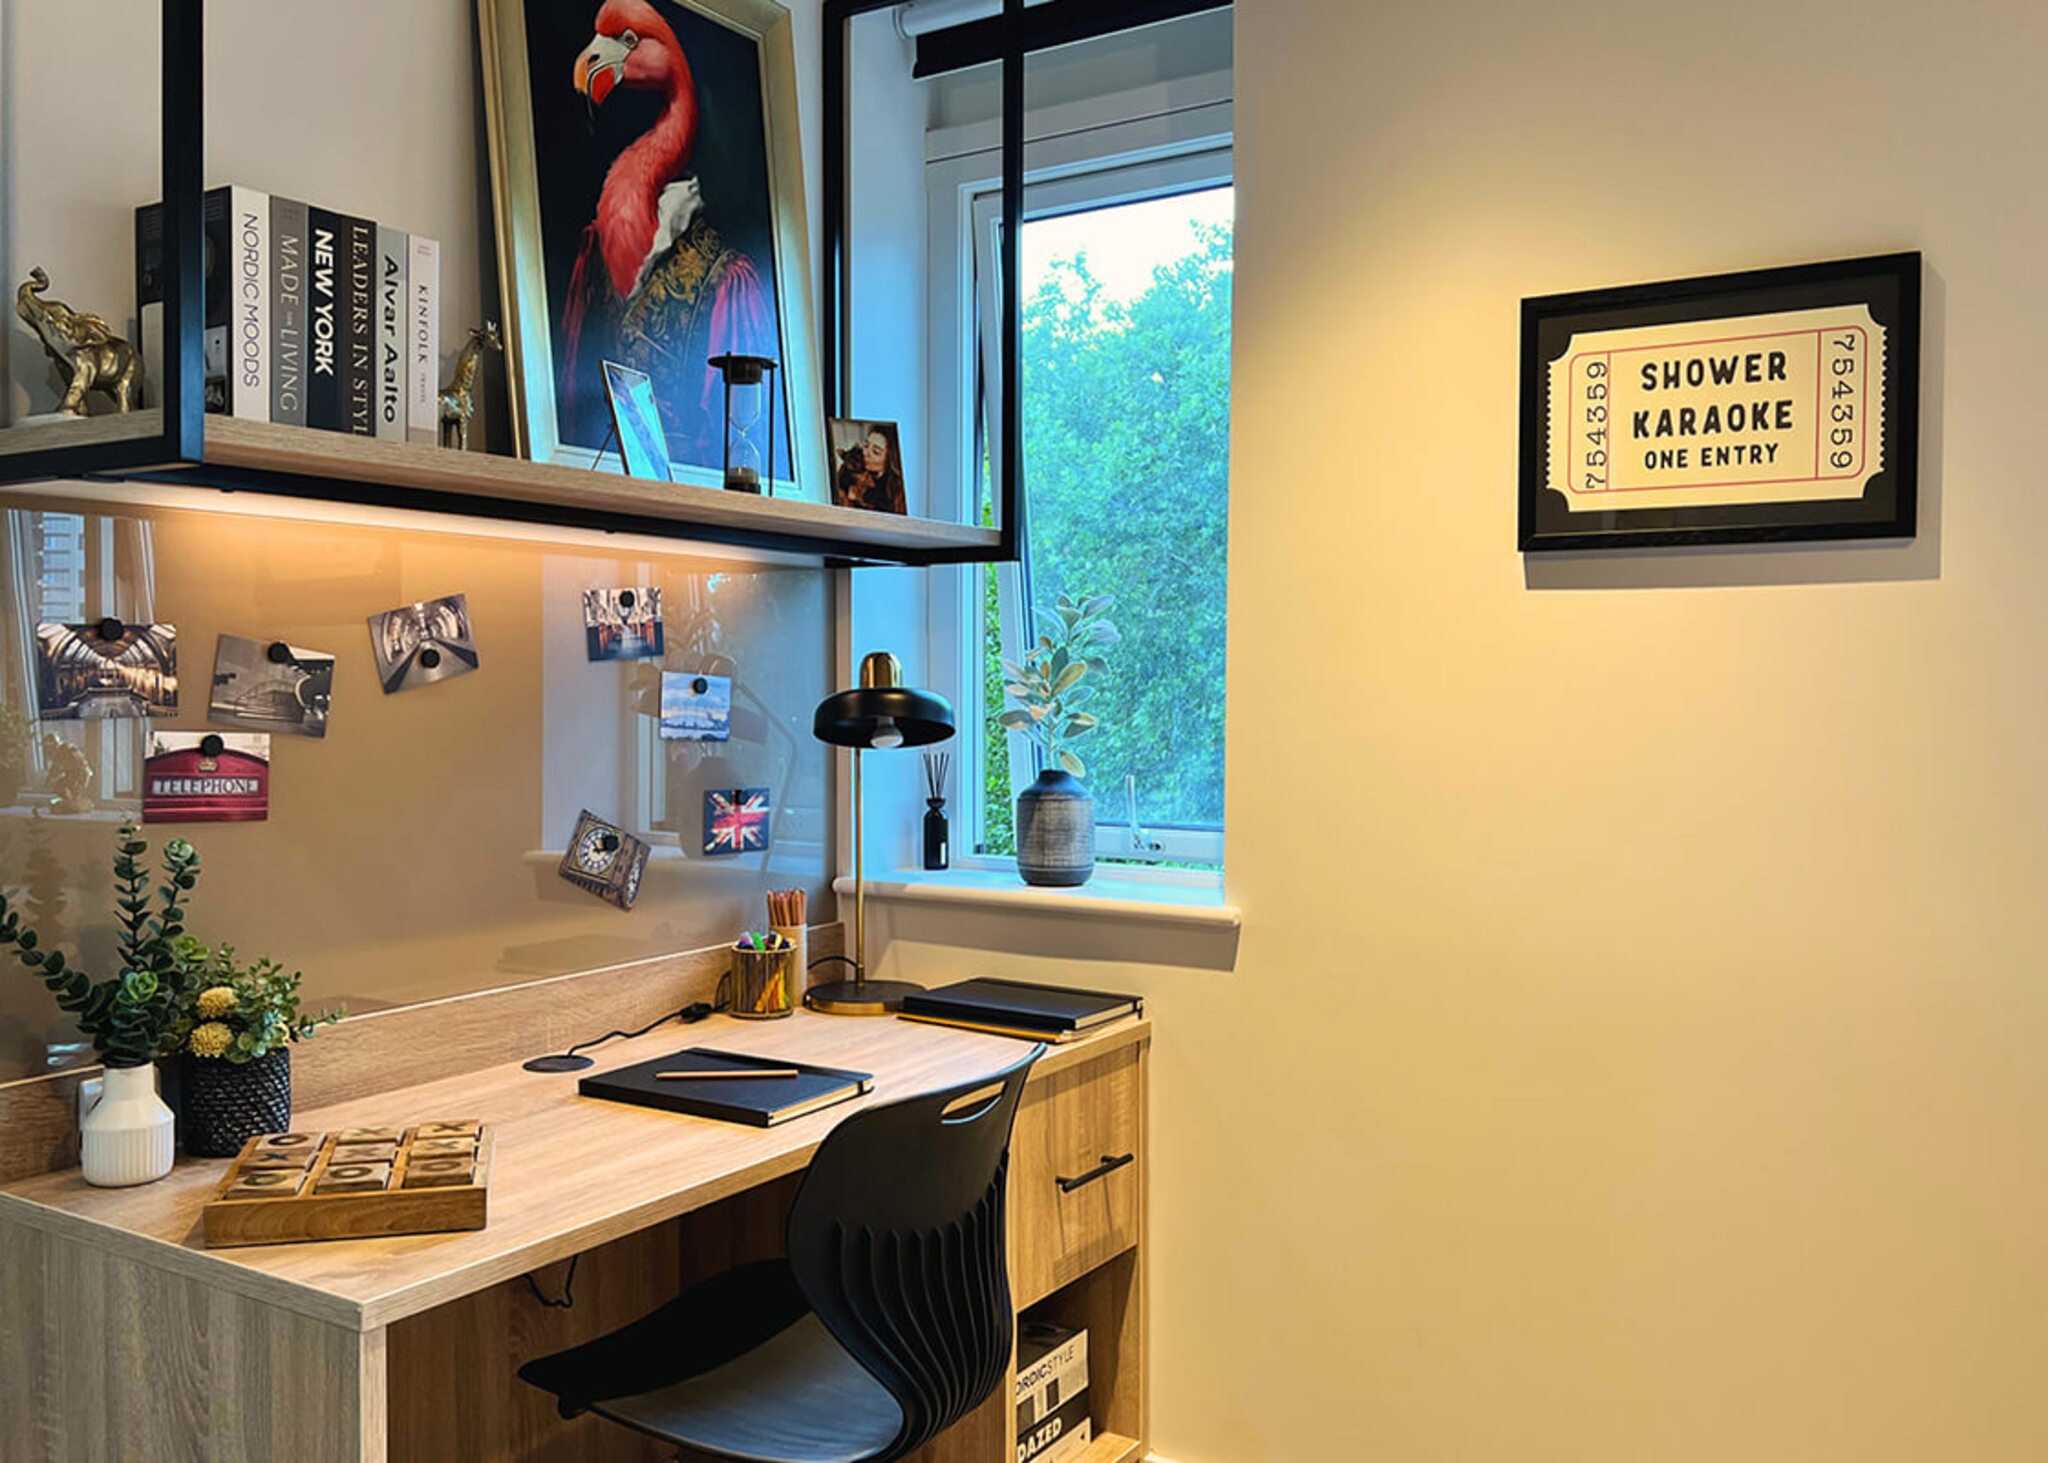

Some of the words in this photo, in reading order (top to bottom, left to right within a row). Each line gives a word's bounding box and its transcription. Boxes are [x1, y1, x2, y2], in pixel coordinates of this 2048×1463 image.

[242, 213, 259, 299] NORDIC
[281, 234, 299, 305] MADE
[315, 228, 334, 298] NEW
[352, 226, 369, 334] LEADERS
[384, 254, 399, 337] Alvar
[418, 284, 429, 364] KINFOLK
[243, 303, 260, 387] MOODS
[280, 328, 299, 411] LIVING
[314, 303, 334, 376] YORK
[352, 343, 369, 370] IN
[1641, 351, 1787, 391] SHOWER
[384, 343, 399, 423] Aalto
[1633, 400, 1793, 439] KARAOKE
[1829, 334, 1856, 469] 754359
[1585, 361, 1608, 489] 754359
[1644, 449, 1688, 469] ONE
[1700, 443, 1779, 467] ENTRY
[156, 778, 259, 794] TELEPHONE
[1017, 1417, 1062, 1463] DAZED
